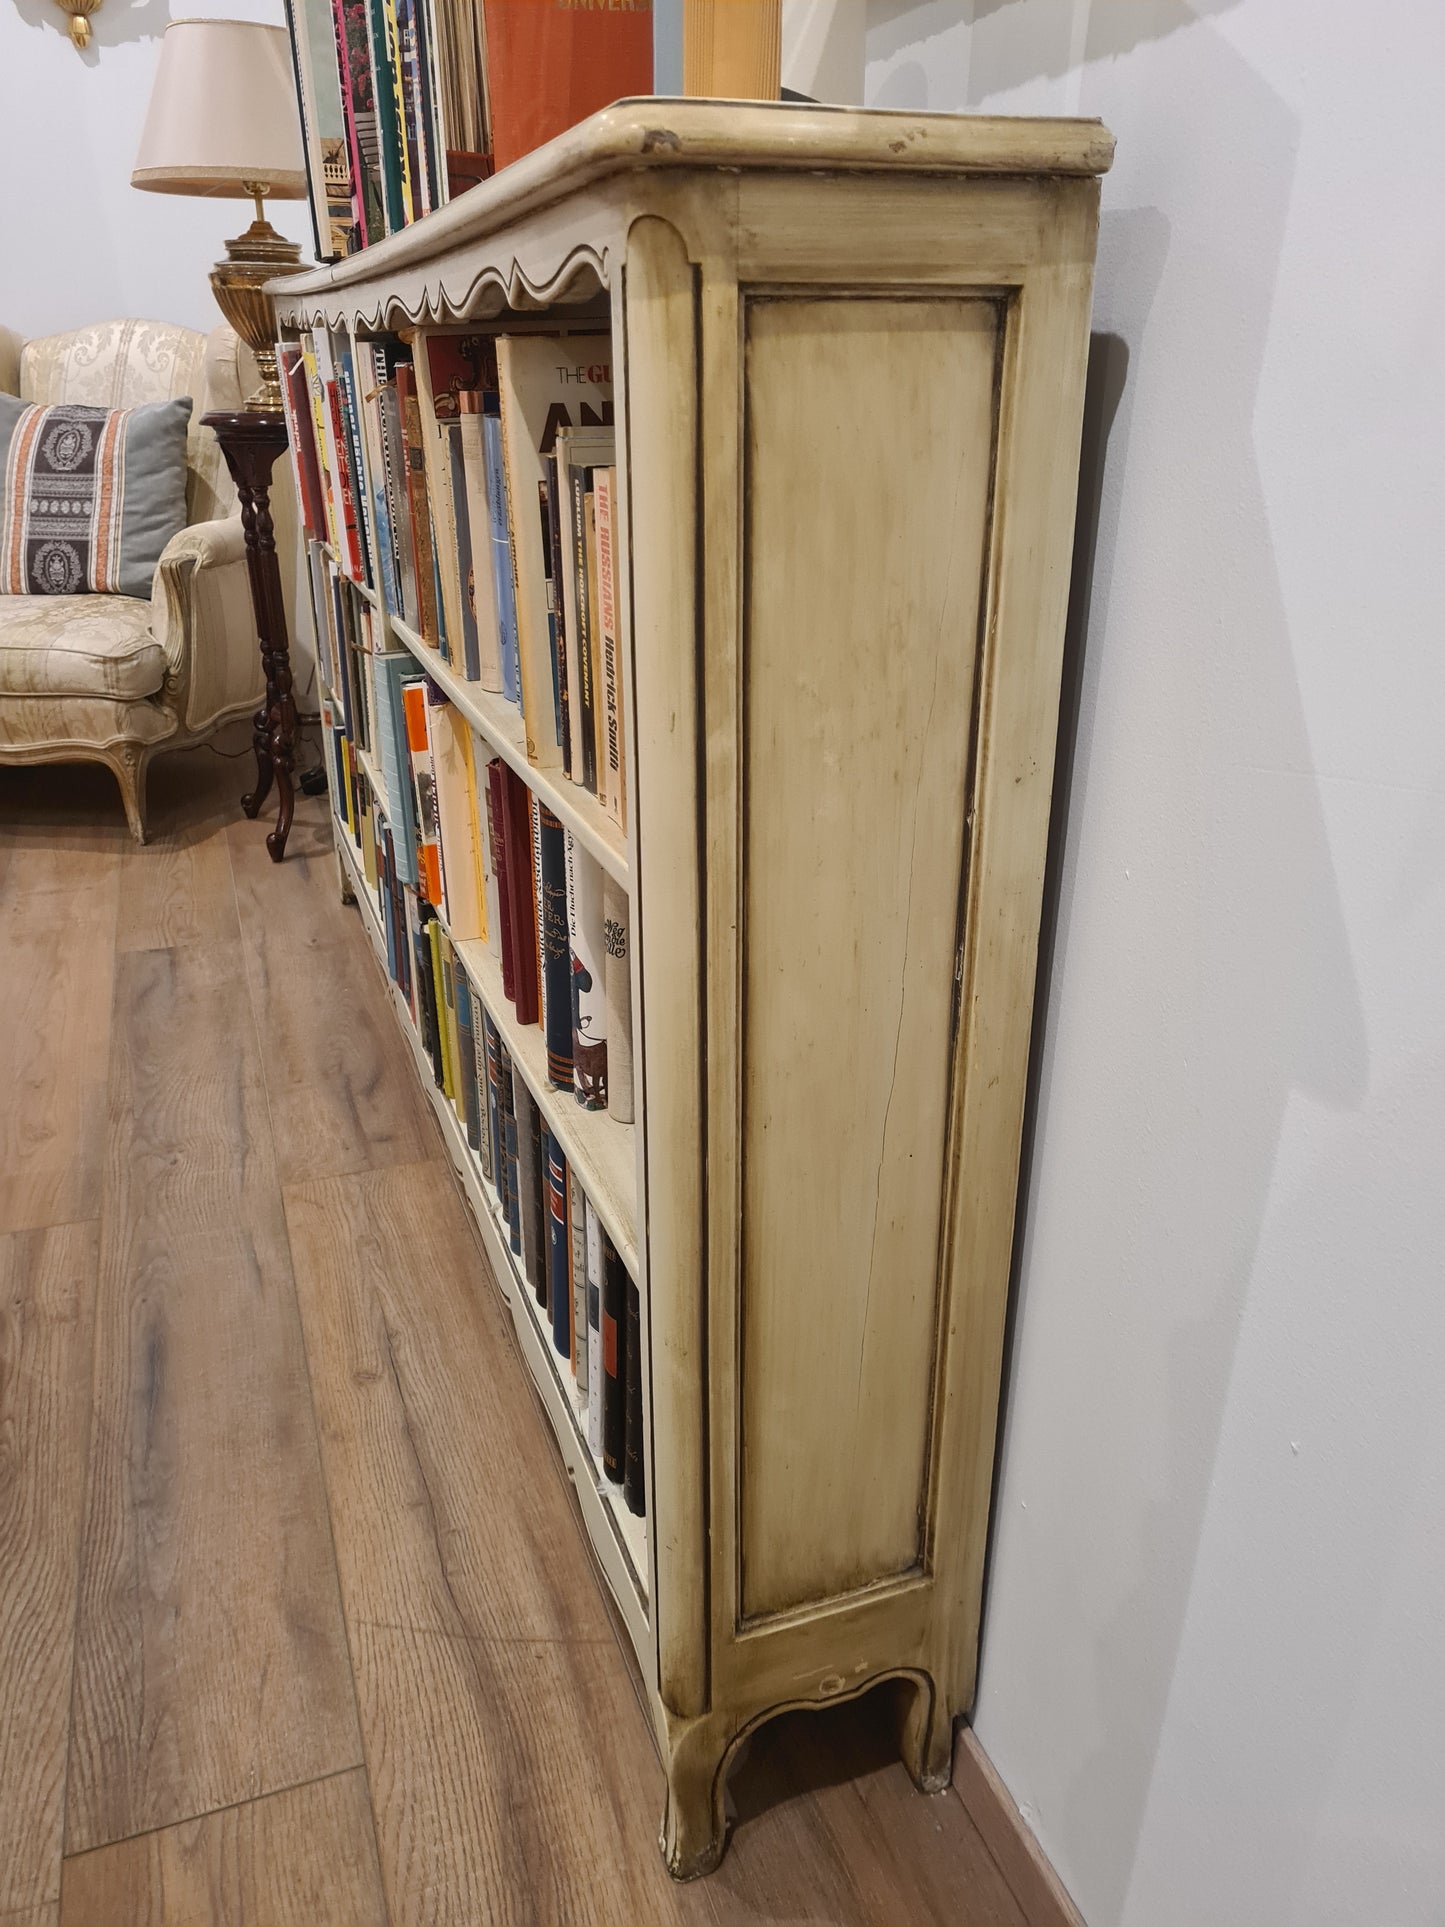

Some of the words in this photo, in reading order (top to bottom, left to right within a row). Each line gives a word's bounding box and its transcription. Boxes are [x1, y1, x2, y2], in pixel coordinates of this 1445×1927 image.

[556, 366, 587, 385] THE
[291, 409, 302, 452] Technik
[574, 479, 583, 537] LUDLUM
[598, 483, 609, 522] THE
[578, 568, 588, 639] HOLCROFT
[599, 526, 615, 631] RUSSIANS
[582, 641, 590, 709] COVENANT
[604, 635, 617, 711] Hedrick
[607, 712, 619, 772] Smith
[568, 857, 576, 882] nach
[568, 884, 577, 917] Flucht
